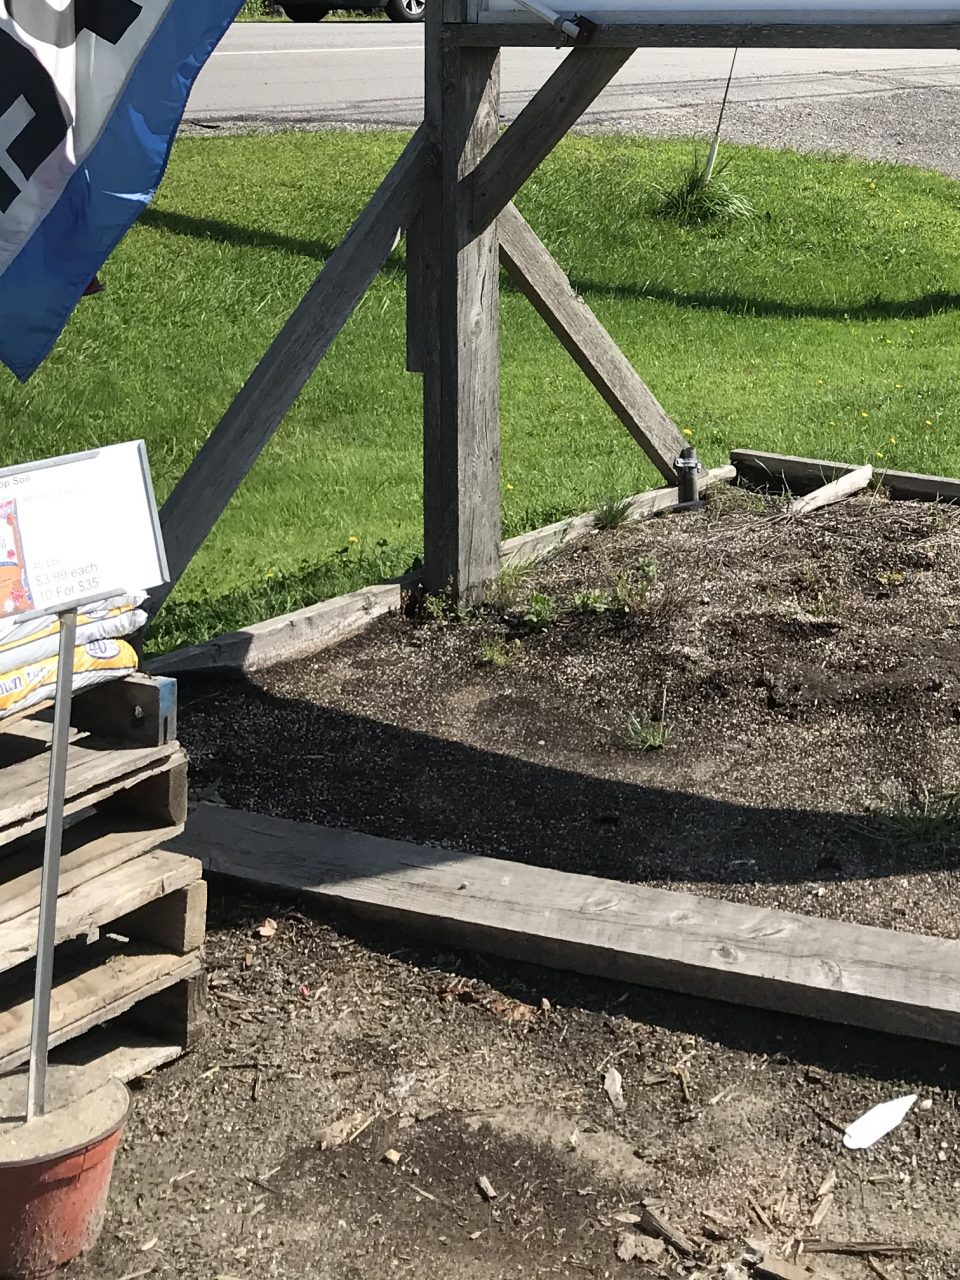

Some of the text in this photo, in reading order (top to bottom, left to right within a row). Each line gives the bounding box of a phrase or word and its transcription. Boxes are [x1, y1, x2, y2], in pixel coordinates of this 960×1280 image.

[12, 473, 31, 485] Soil
[70, 561, 98, 577] each
[78, 576, 99, 592] $35
